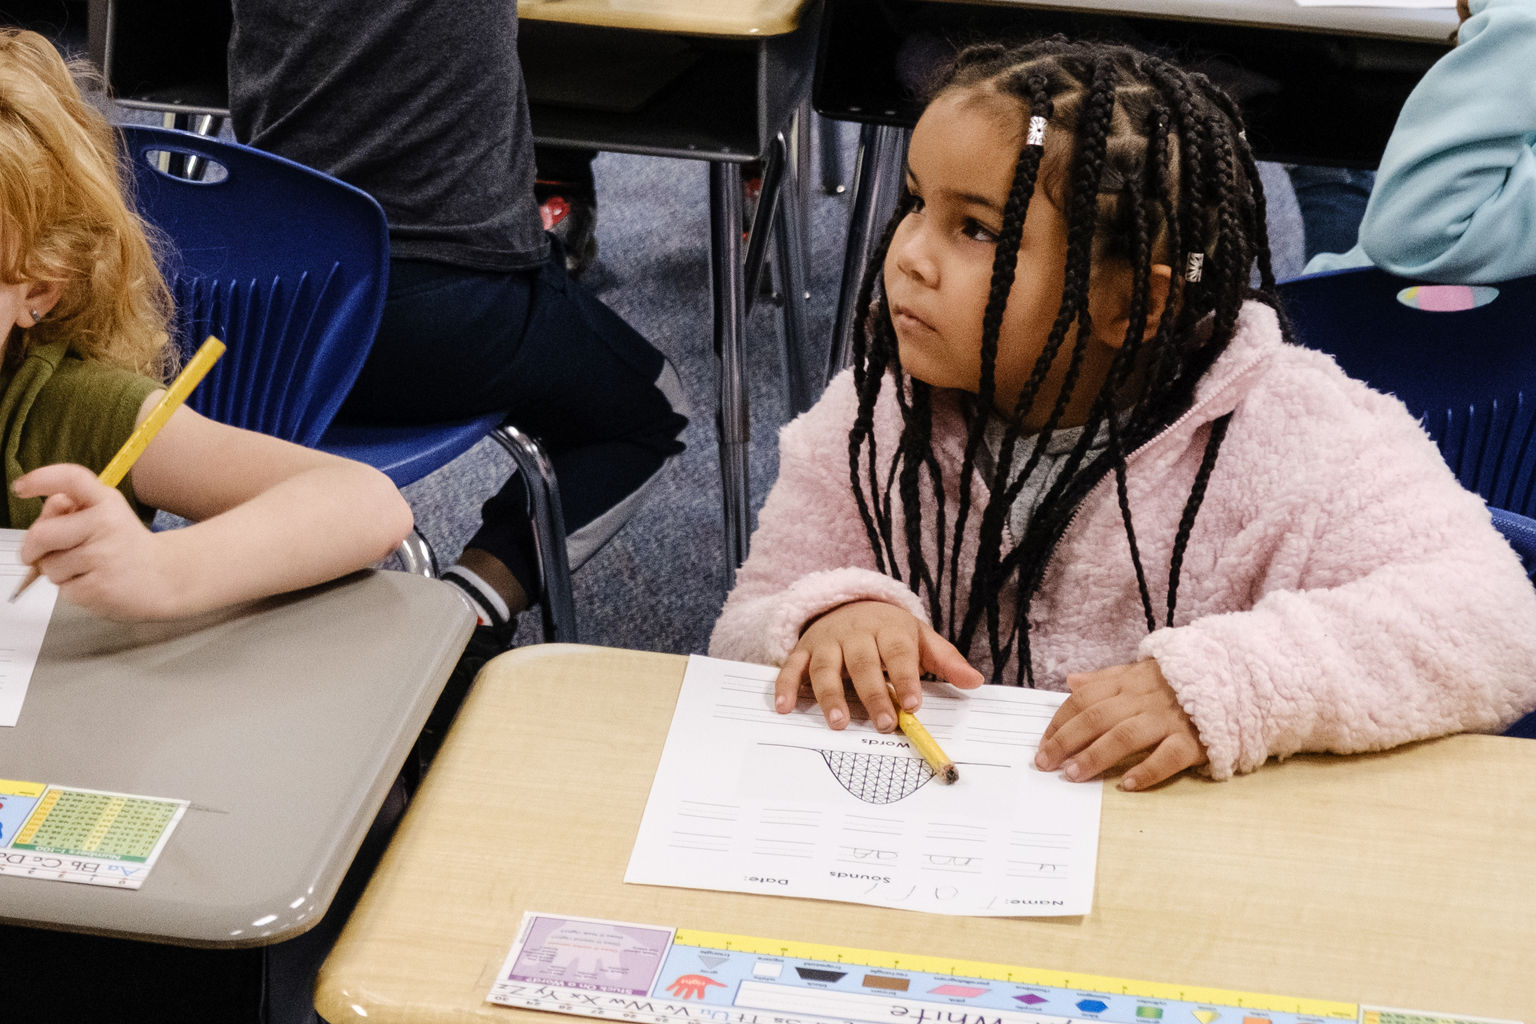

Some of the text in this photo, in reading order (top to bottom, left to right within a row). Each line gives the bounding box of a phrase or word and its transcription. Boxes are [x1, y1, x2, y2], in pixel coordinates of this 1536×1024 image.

[861, 738, 910, 749] Words
[69, 849, 121, 860] Numbers
[33, 856, 62, 868] Cc
[71, 861, 100, 872] Bb
[108, 865, 139, 876] Aa
[744, 876, 789, 885] Date:
[829, 871, 890, 883] Sounds
[524, 978, 565, 987] Word?
[600, 985, 633, 994] Stuck
[498, 984, 689, 1016] Vv Ww Xx Yy Zz
